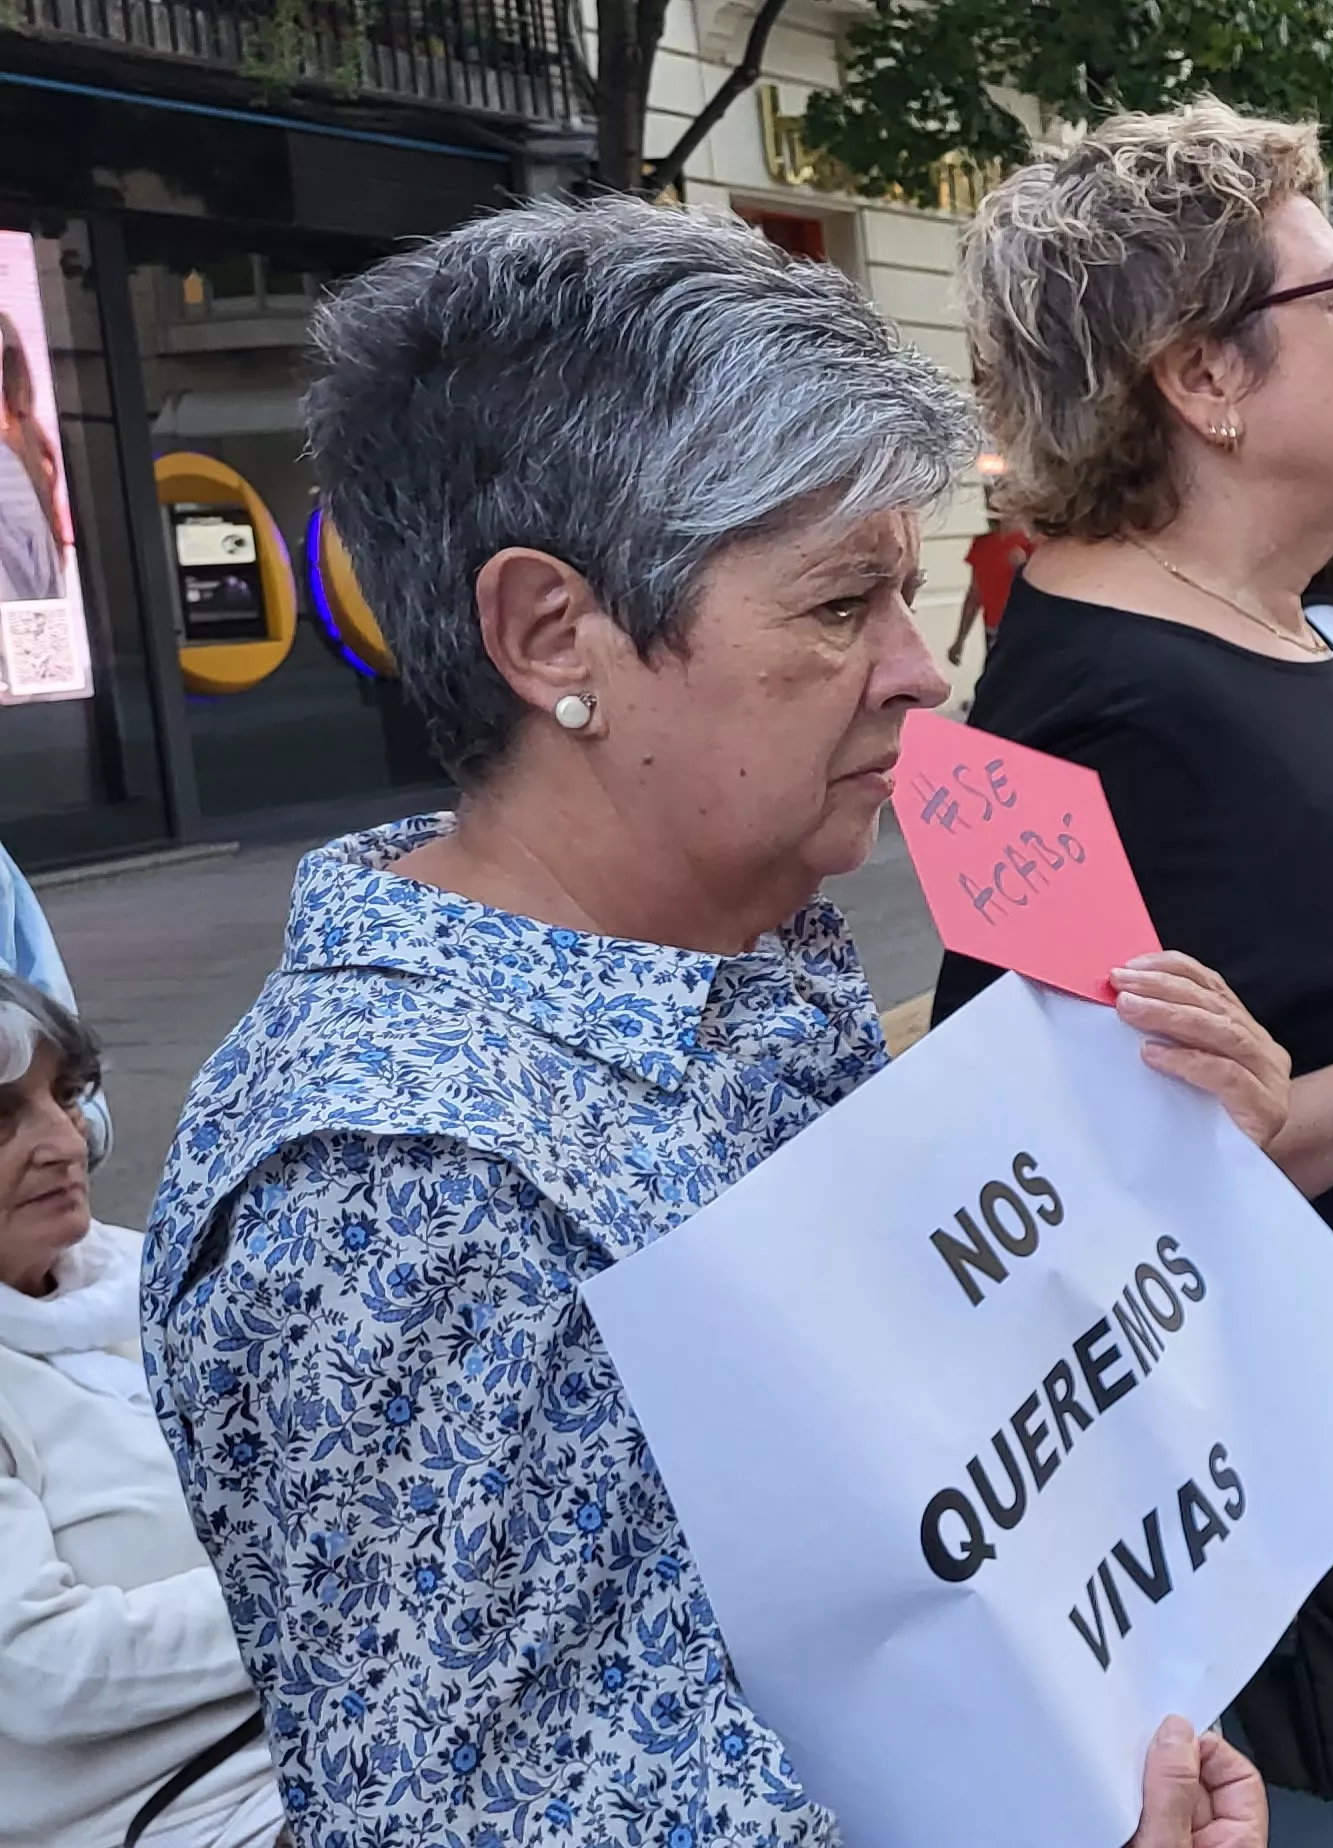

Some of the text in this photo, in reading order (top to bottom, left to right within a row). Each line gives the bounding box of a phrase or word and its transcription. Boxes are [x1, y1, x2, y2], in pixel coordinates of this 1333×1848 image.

[910, 758, 1018, 835] #SE
[928, 1151, 1065, 1308] NOS
[919, 1234, 1208, 1583] QUEREMOS
[1068, 1441, 1248, 1674] VIVAS
